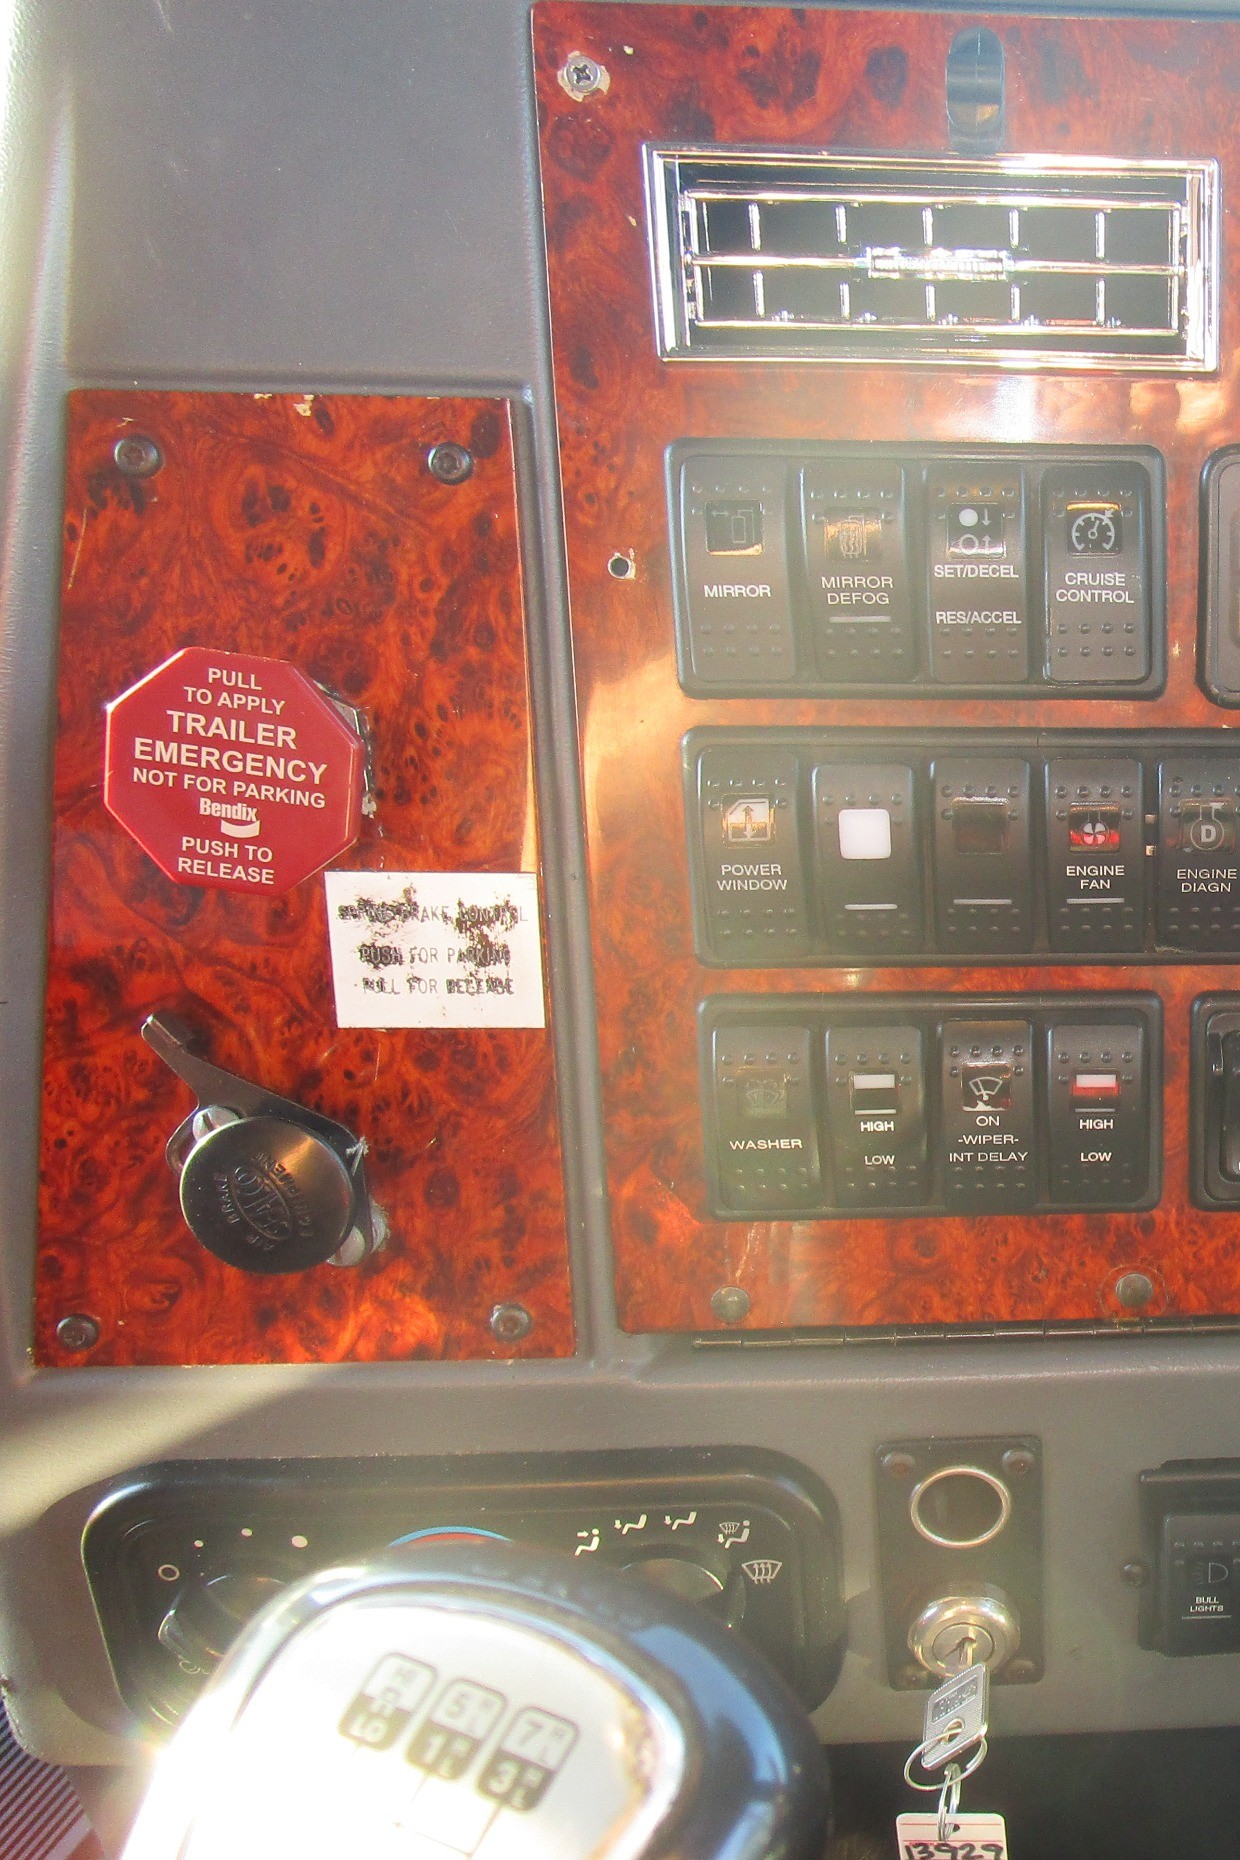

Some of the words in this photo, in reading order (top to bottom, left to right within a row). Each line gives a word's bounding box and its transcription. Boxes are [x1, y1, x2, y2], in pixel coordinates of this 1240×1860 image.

[934, 565, 1019, 578] SET/DECEL
[821, 576, 893, 589] MIRROR
[1065, 573, 1125, 586] CRUISE
[704, 584, 771, 598] MIRROR
[1056, 590, 1134, 603] CONTROL
[827, 593, 889, 604] DEFOG
[935, 611, 1021, 624] RES/ACCEL
[208, 667, 262, 690] PULL
[184, 686, 212, 705] TO
[217, 692, 285, 715] APPLY
[166, 710, 297, 749] TRAILER
[134, 737, 327, 785] EMERGENCY
[133, 768, 178, 787] NOT
[183, 775, 227, 794] FOR
[233, 781, 326, 809] PARKING
[199, 798, 258, 822] Bendix
[1201, 825, 1216, 843] D
[182, 836, 238, 858] PUSH
[245, 845, 272, 863] TO
[178, 857, 275, 885] RELEASE
[721, 864, 782, 877] POWER
[1065, 865, 1125, 877] ENGINE
[1176, 869, 1237, 879] ENGINE
[717, 878, 788, 891] WINDOW
[1080, 878, 1111, 889] FAN
[1181, 883, 1231, 892] DIAGN
[409, 948, 438, 963] FOR
[409, 978, 438, 994] FOR
[860, 1121, 894, 1133] HIGH
[975, 1115, 1000, 1127] ON
[1079, 1119, 1114, 1130] HIGH
[729, 1138, 803, 1150] WASHER
[864, 1154, 895, 1166] LOW
[949, 1152, 975, 1163] INT
[977, 1151, 1028, 1163] DELAY
[1080, 1151, 1112, 1163] LOW
[1196, 1596, 1219, 1604] BULL
[1190, 1605, 1224, 1613] LIGHTS
[422, 1733, 447, 1764] 1
[488, 1762, 520, 1794] 3
